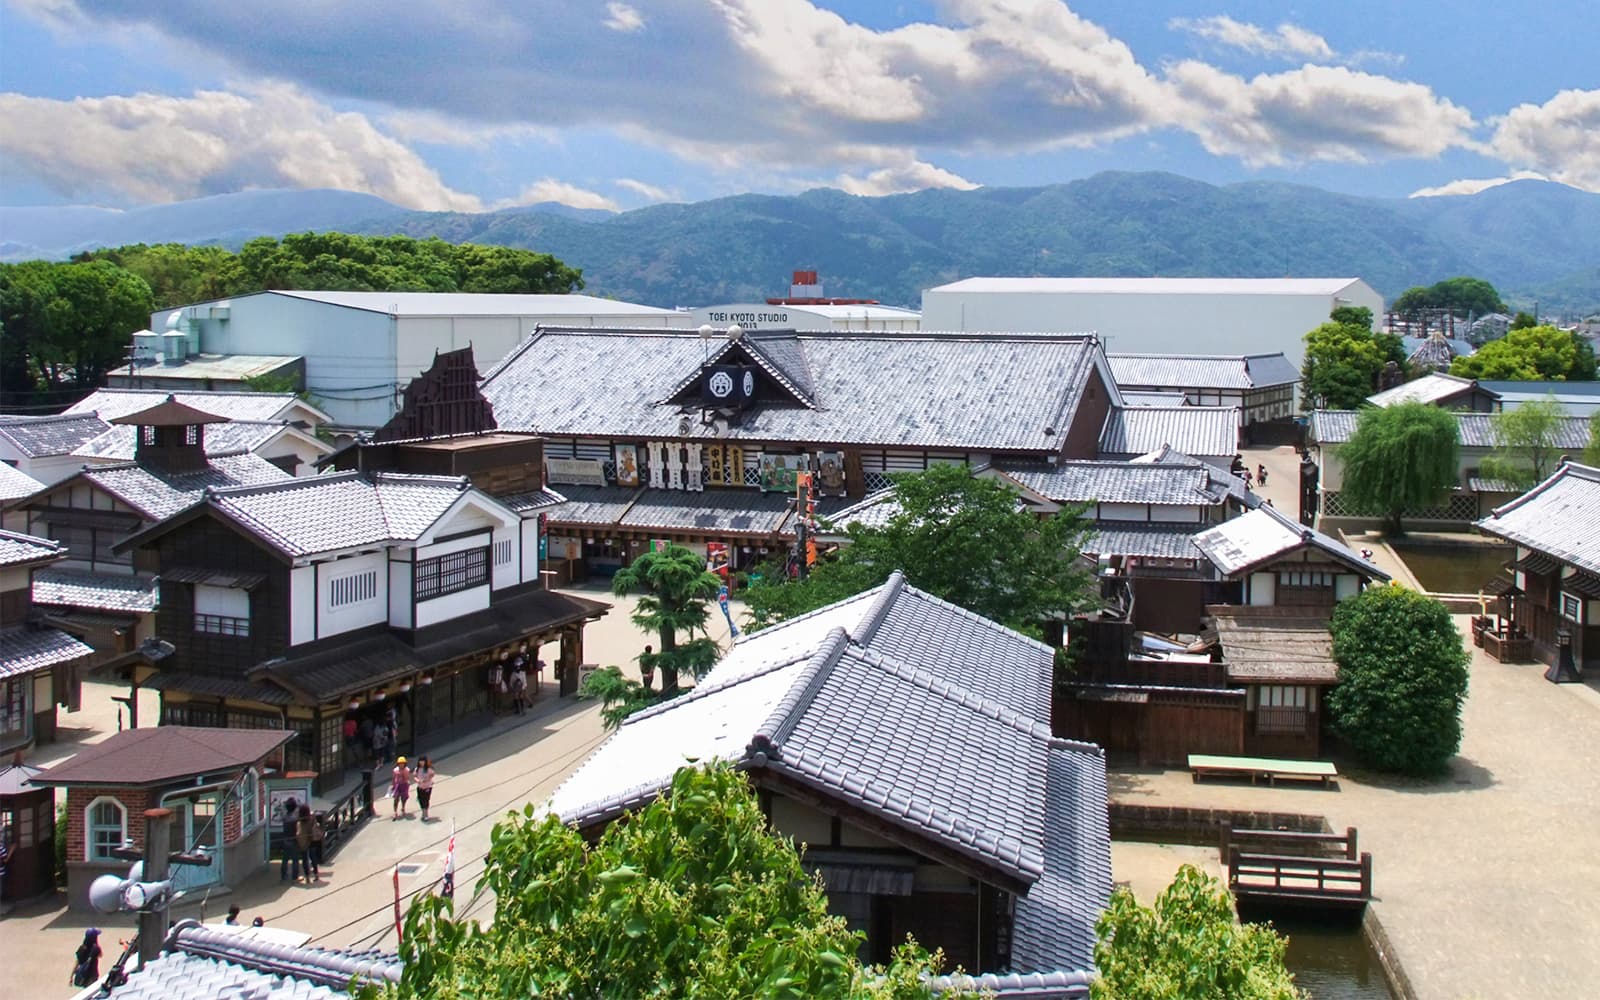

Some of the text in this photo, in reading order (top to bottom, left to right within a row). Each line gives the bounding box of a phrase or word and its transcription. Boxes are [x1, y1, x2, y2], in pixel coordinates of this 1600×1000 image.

[709, 312, 788, 322] TOEI KYOTO STUDIO
